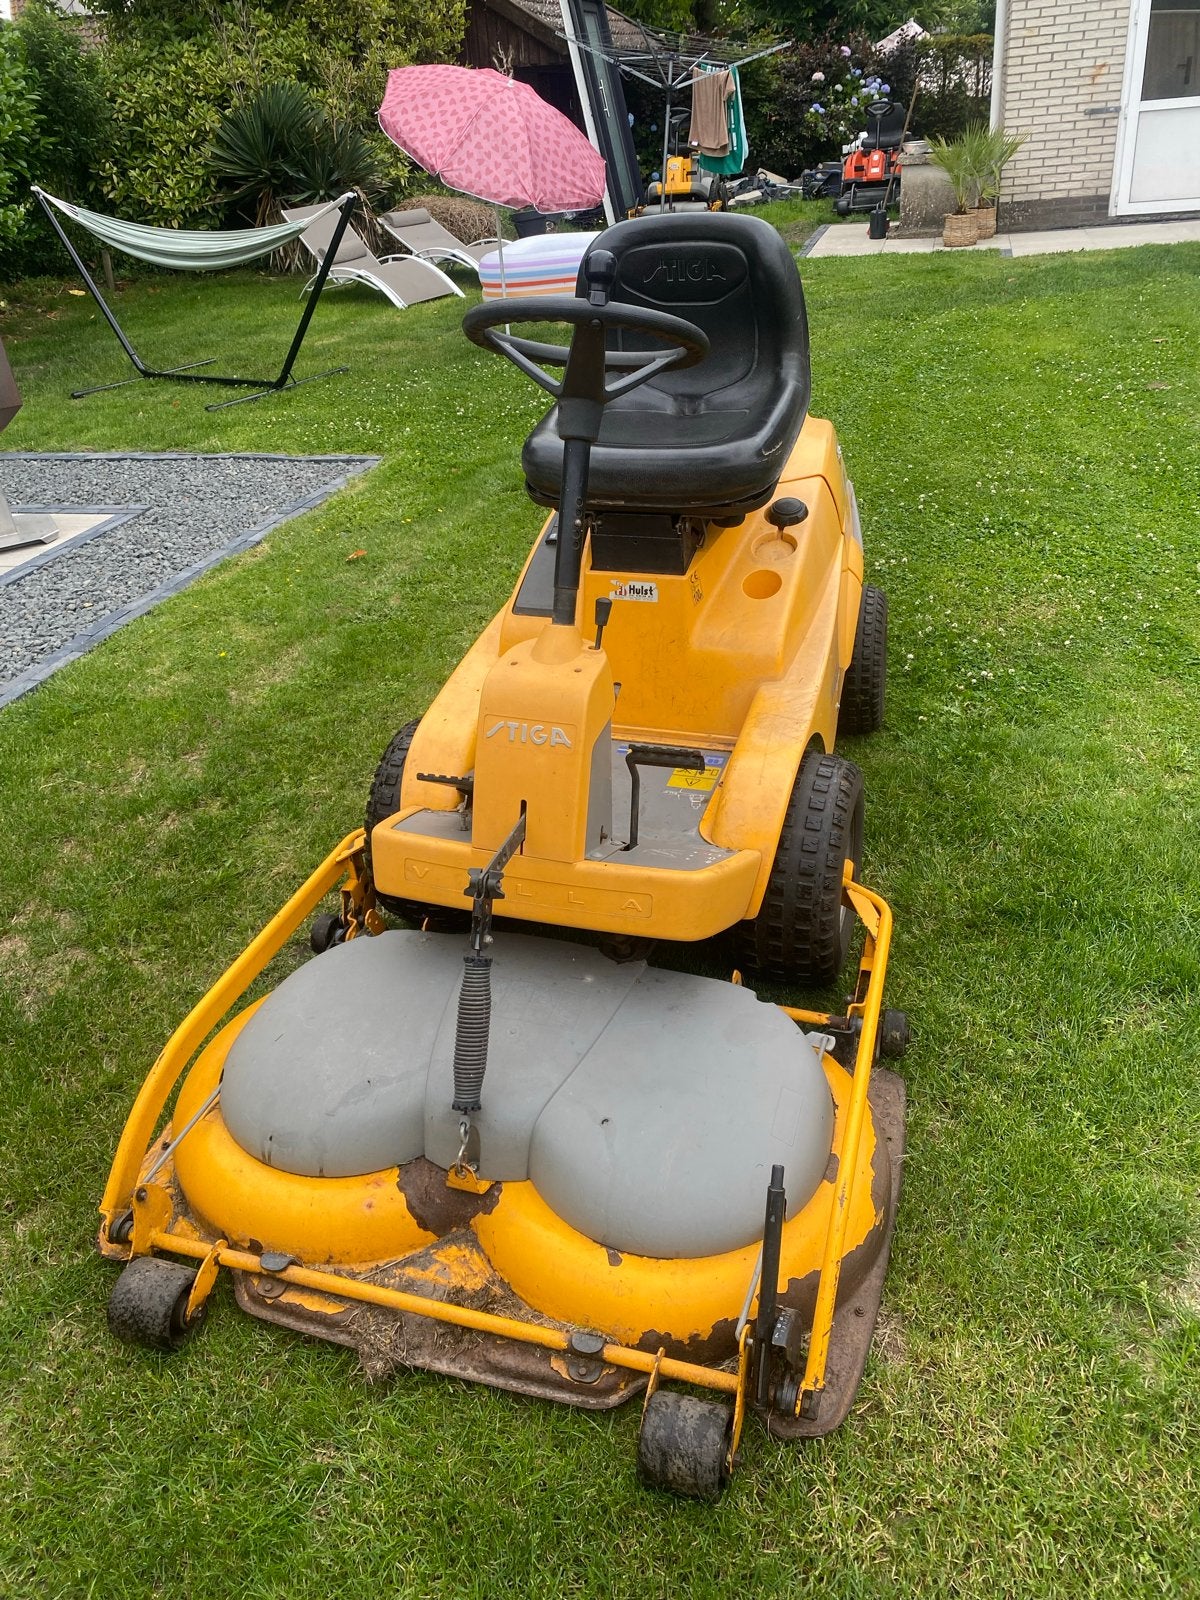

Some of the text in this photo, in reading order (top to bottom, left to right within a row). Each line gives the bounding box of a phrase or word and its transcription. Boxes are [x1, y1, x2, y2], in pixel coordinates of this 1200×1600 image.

[644, 259, 726, 282] STIGA
[629, 584, 654, 596] Hulst
[486, 721, 571, 748] STIGA
[412, 865, 642, 912] VLLA
